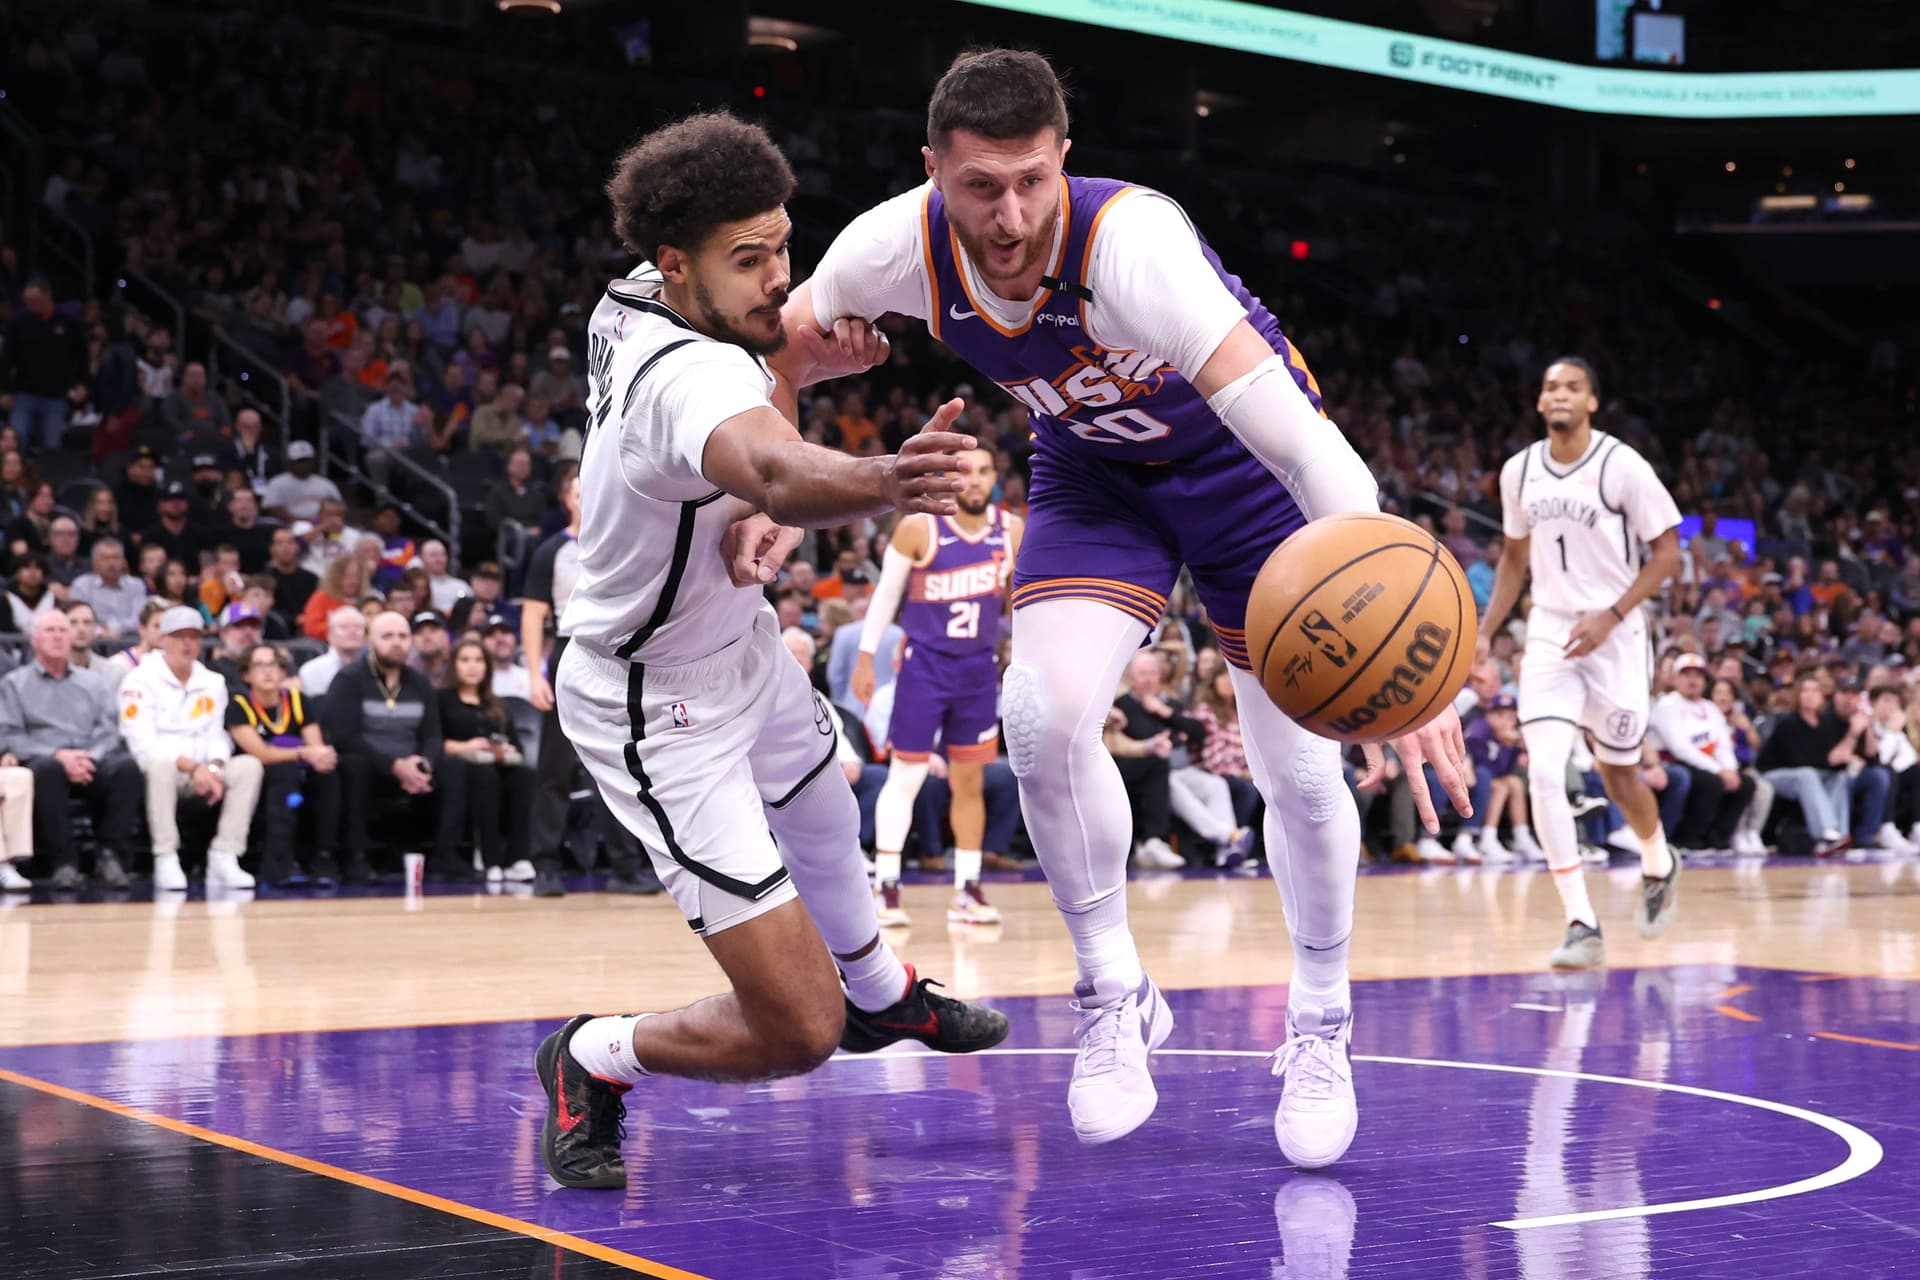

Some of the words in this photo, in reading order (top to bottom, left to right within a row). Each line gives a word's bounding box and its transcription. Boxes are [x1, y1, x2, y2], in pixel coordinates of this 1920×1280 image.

[1555, 533, 1568, 573] 1
[924, 563, 997, 601] SUNS
[946, 600, 981, 638] 21
[1326, 621, 1452, 734] Wilson
